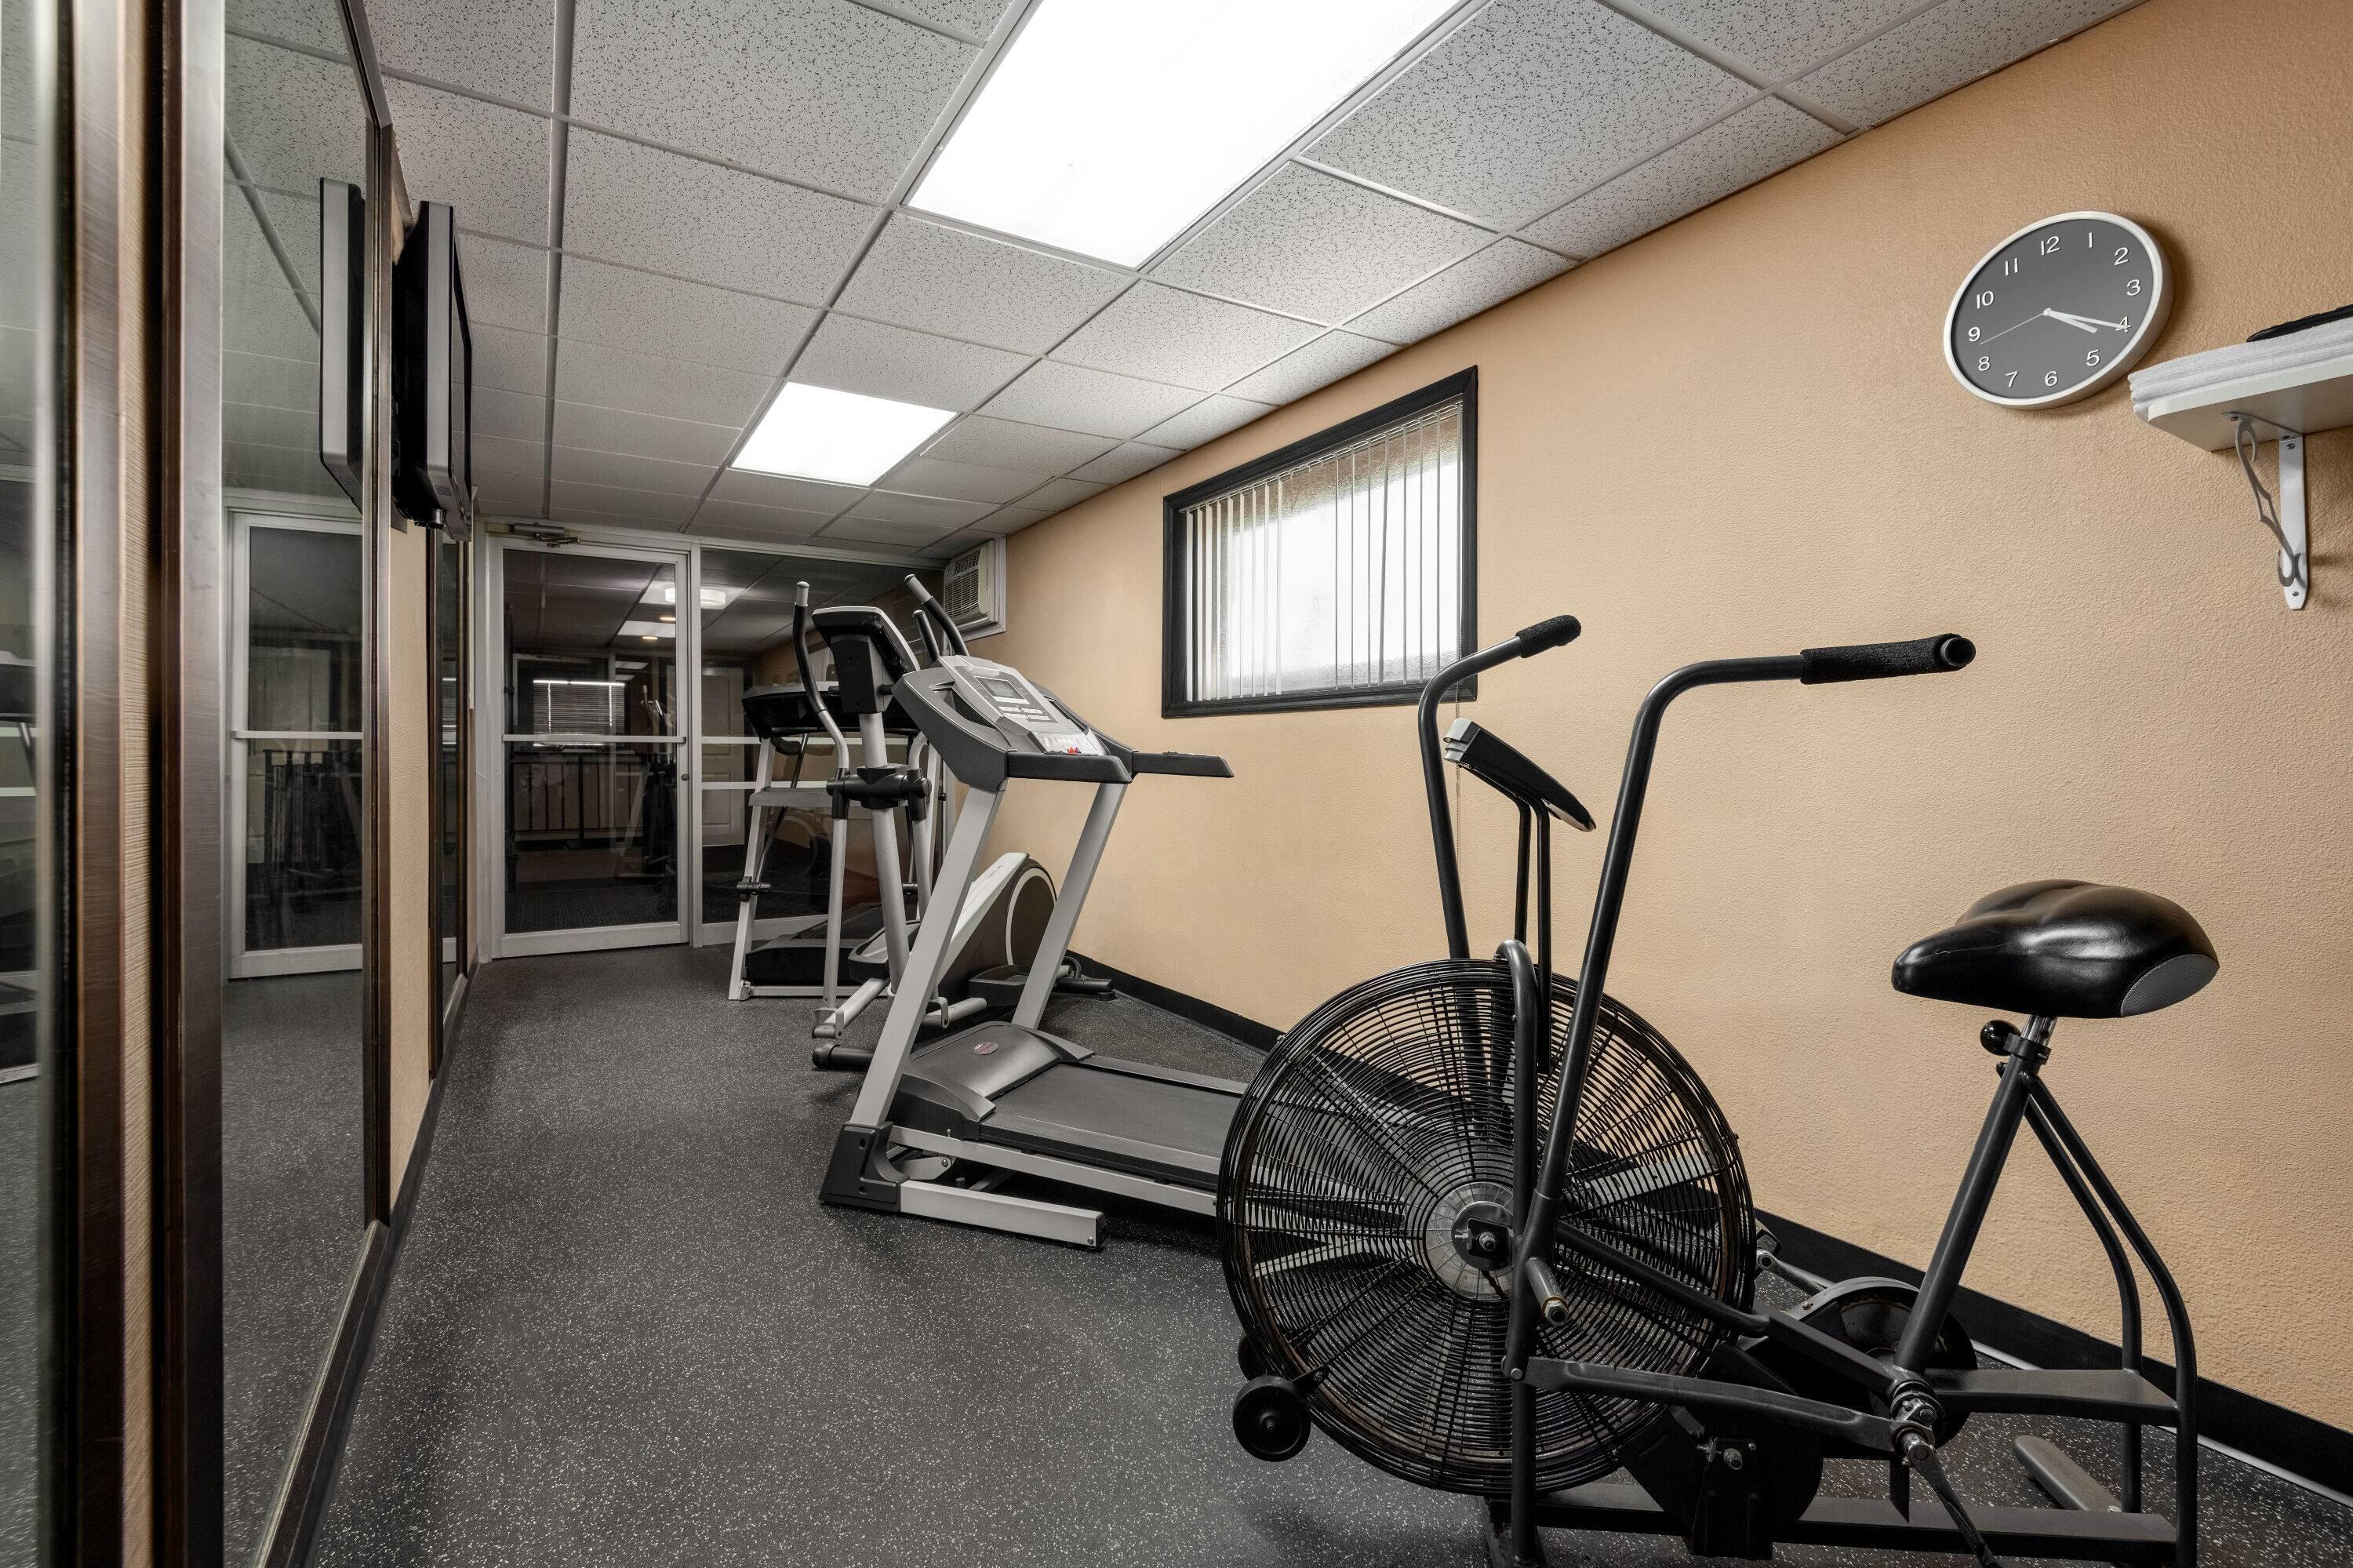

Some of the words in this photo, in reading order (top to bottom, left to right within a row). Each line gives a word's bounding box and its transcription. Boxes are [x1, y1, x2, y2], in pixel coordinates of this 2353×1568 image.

[2041, 235, 2060, 256] 12
[2089, 231, 2093, 249] 1
[2114, 247, 2129, 266] 2
[2005, 257, 2019, 276] 11
[2126, 278, 2141, 297] 3
[1976, 290, 1995, 309] 10
[2115, 315, 2131, 333] 4
[1968, 326, 1980, 342] 9
[1977, 355, 1991, 372] 8
[2086, 349, 2100, 366] 5
[2005, 370, 2019, 387] 7
[2044, 370, 2058, 387] 6
